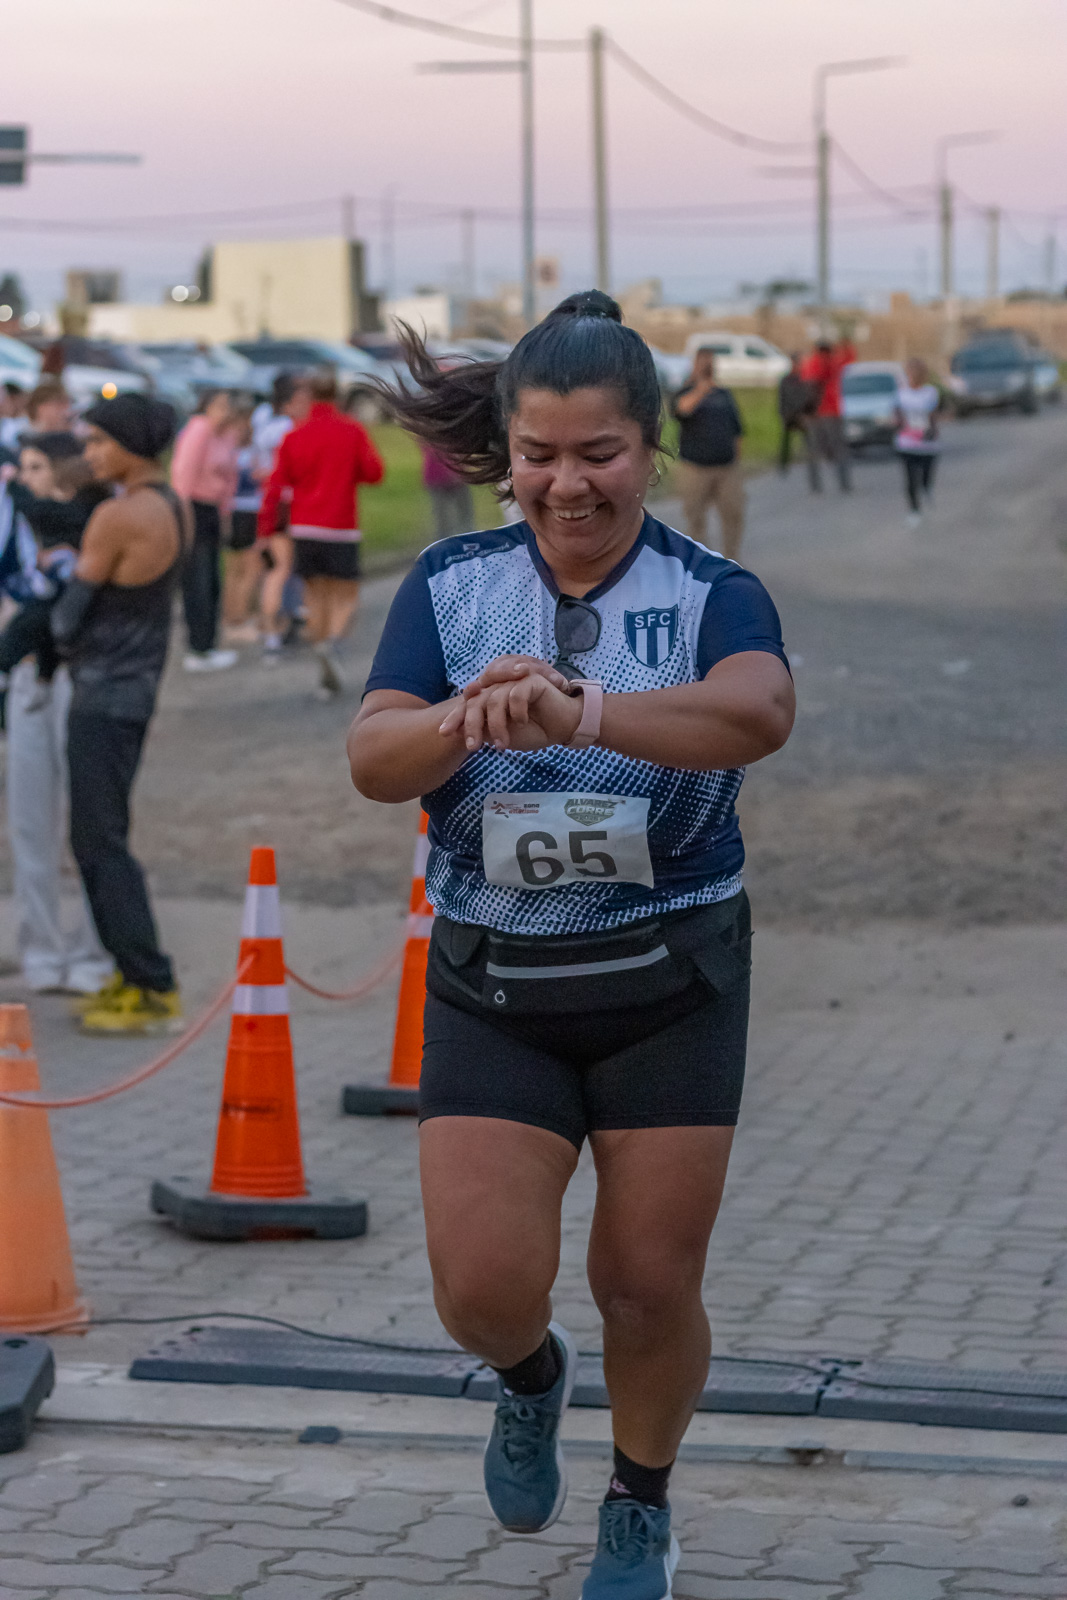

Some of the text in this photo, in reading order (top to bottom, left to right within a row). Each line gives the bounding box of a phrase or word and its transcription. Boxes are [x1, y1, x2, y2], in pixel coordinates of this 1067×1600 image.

[634, 612, 671, 628] SFC
[567, 805, 614, 815] CORRE
[568, 799, 617, 808] ALVAREZ
[516, 830, 618, 886] 65
